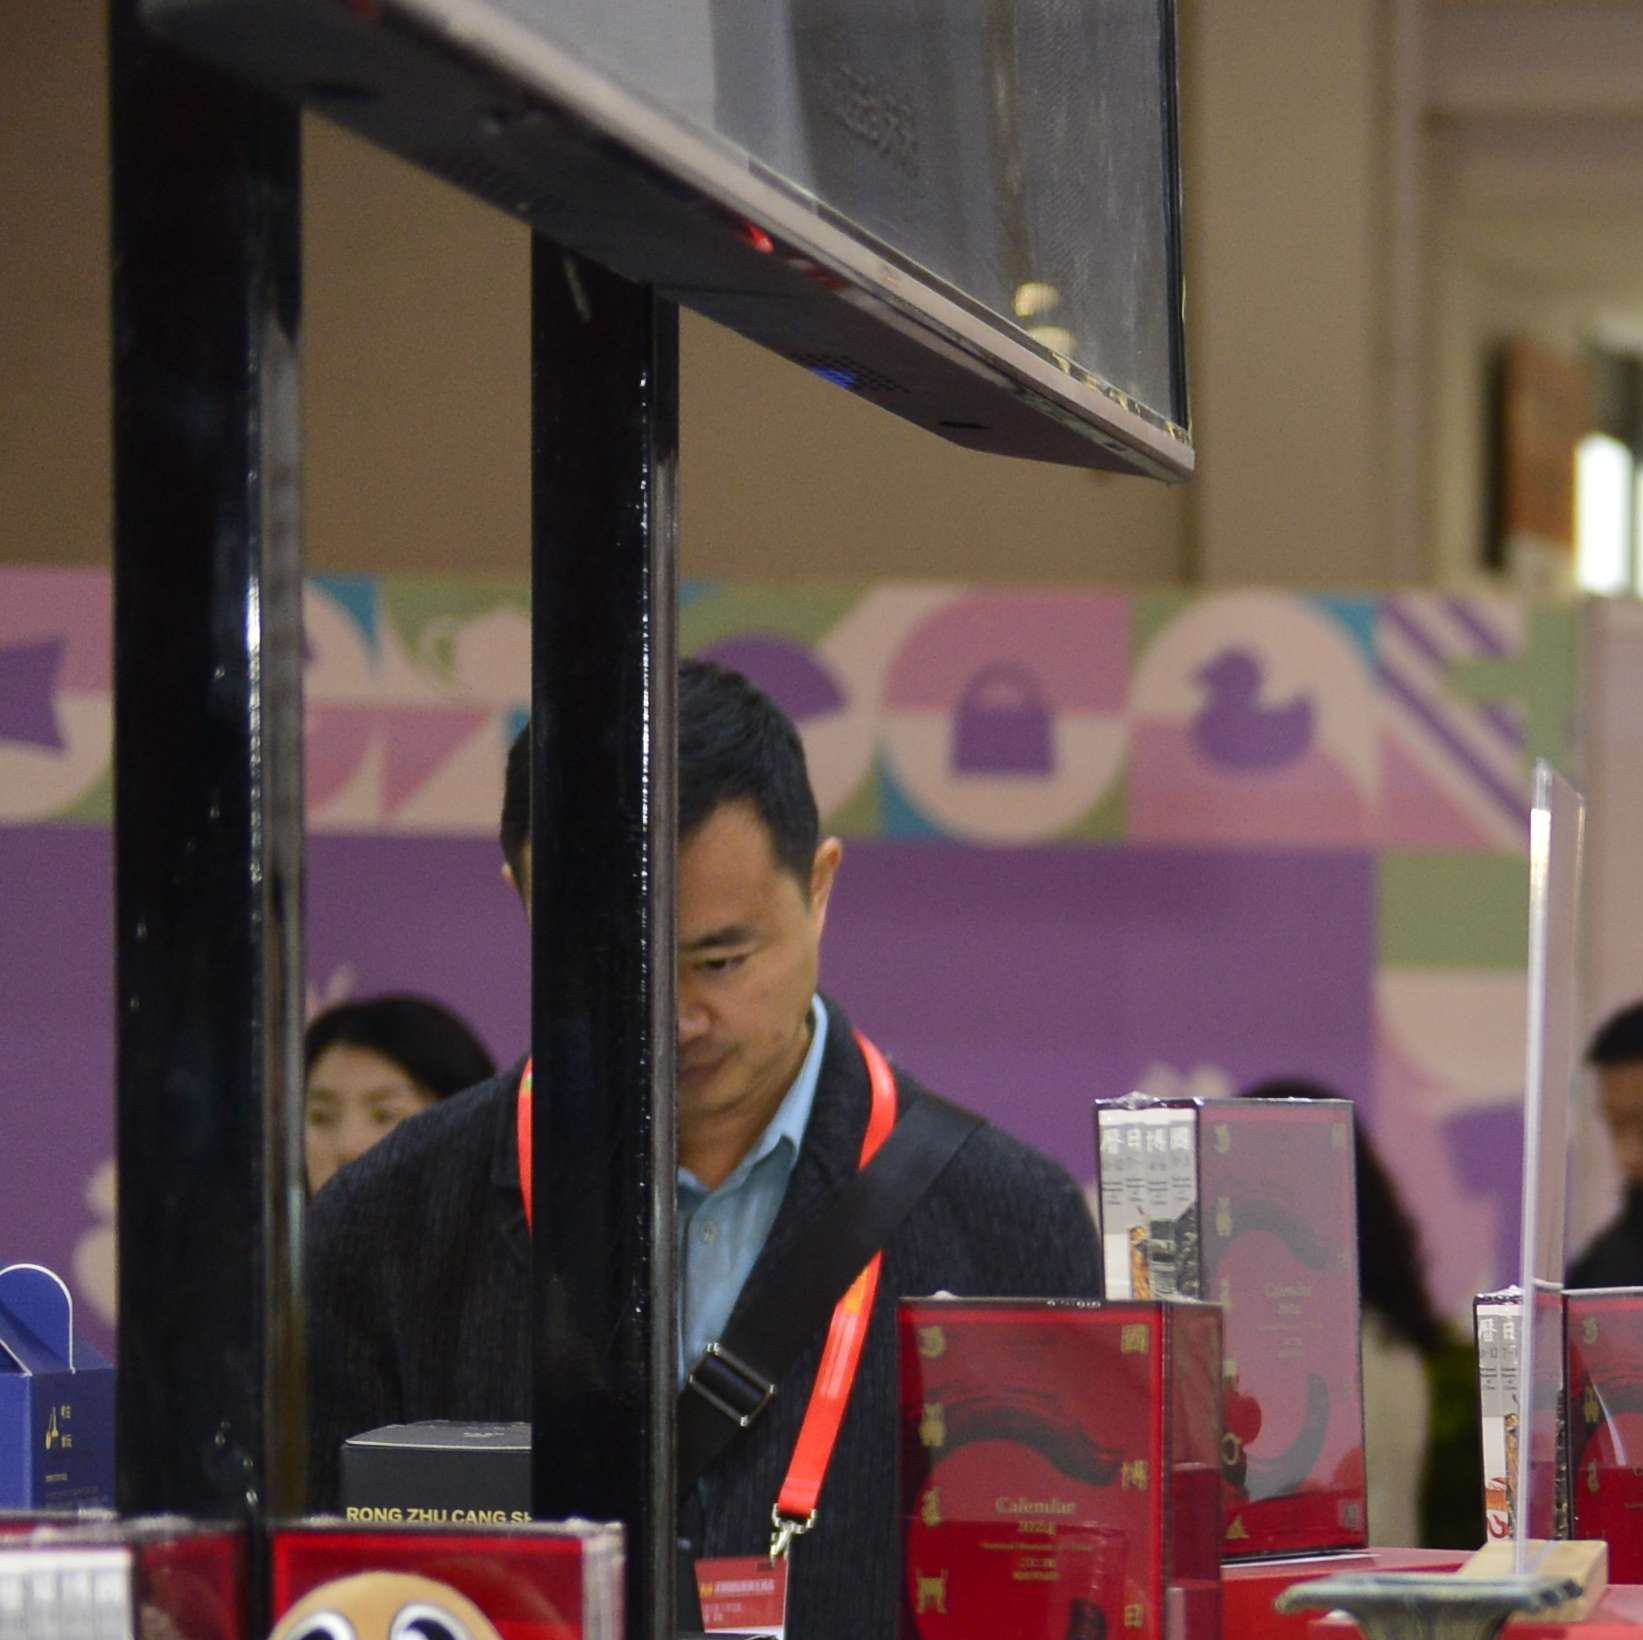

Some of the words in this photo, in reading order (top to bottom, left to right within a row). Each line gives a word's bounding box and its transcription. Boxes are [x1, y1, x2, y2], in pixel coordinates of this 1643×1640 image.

[995, 1495, 1077, 1515] Calendar
[346, 1507, 403, 1522] RONG
[407, 1509, 447, 1523] ZHU
[452, 1510, 506, 1524] CANG
